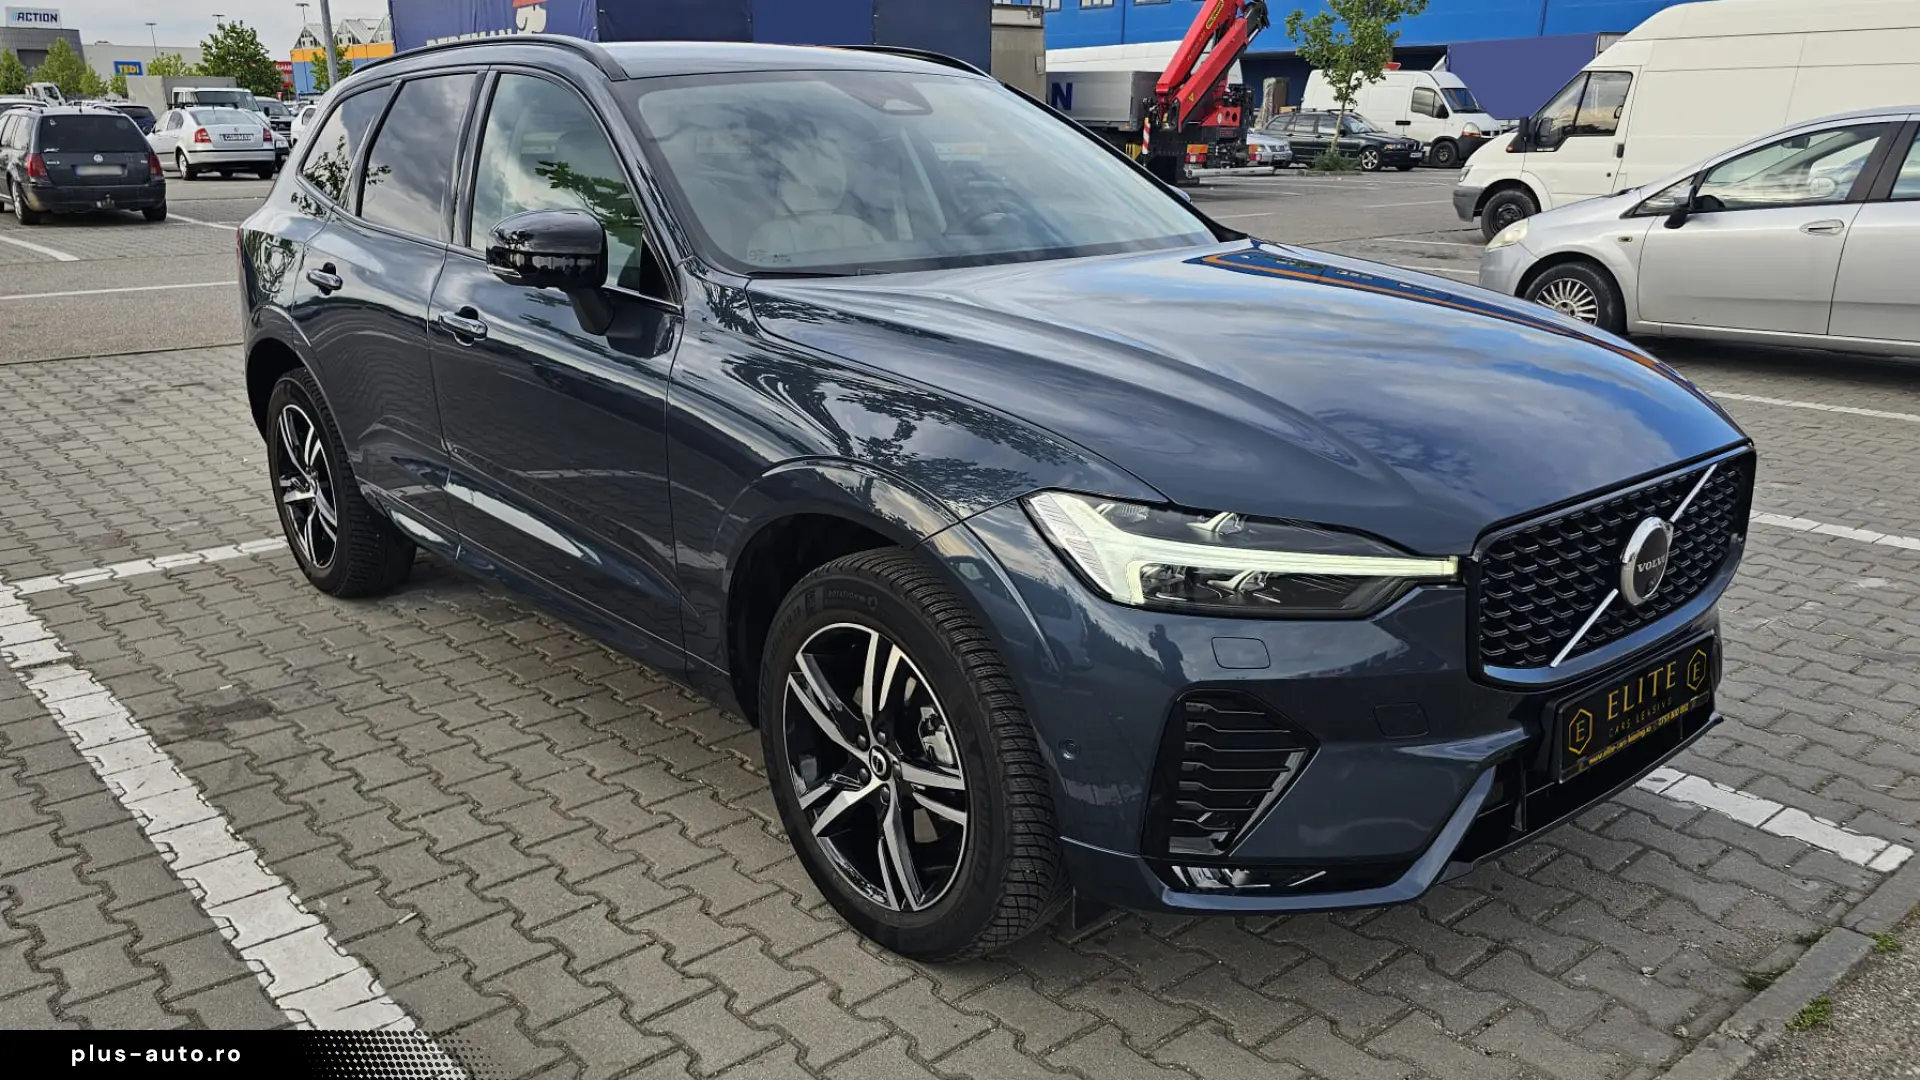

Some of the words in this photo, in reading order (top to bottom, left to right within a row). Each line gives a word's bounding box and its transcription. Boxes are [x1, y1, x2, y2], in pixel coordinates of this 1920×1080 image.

[17, 12, 58, 22] ACTION
[1692, 661, 1701, 682] E
[1607, 660, 1677, 720] ELITE
[1576, 719, 1585, 742] E
